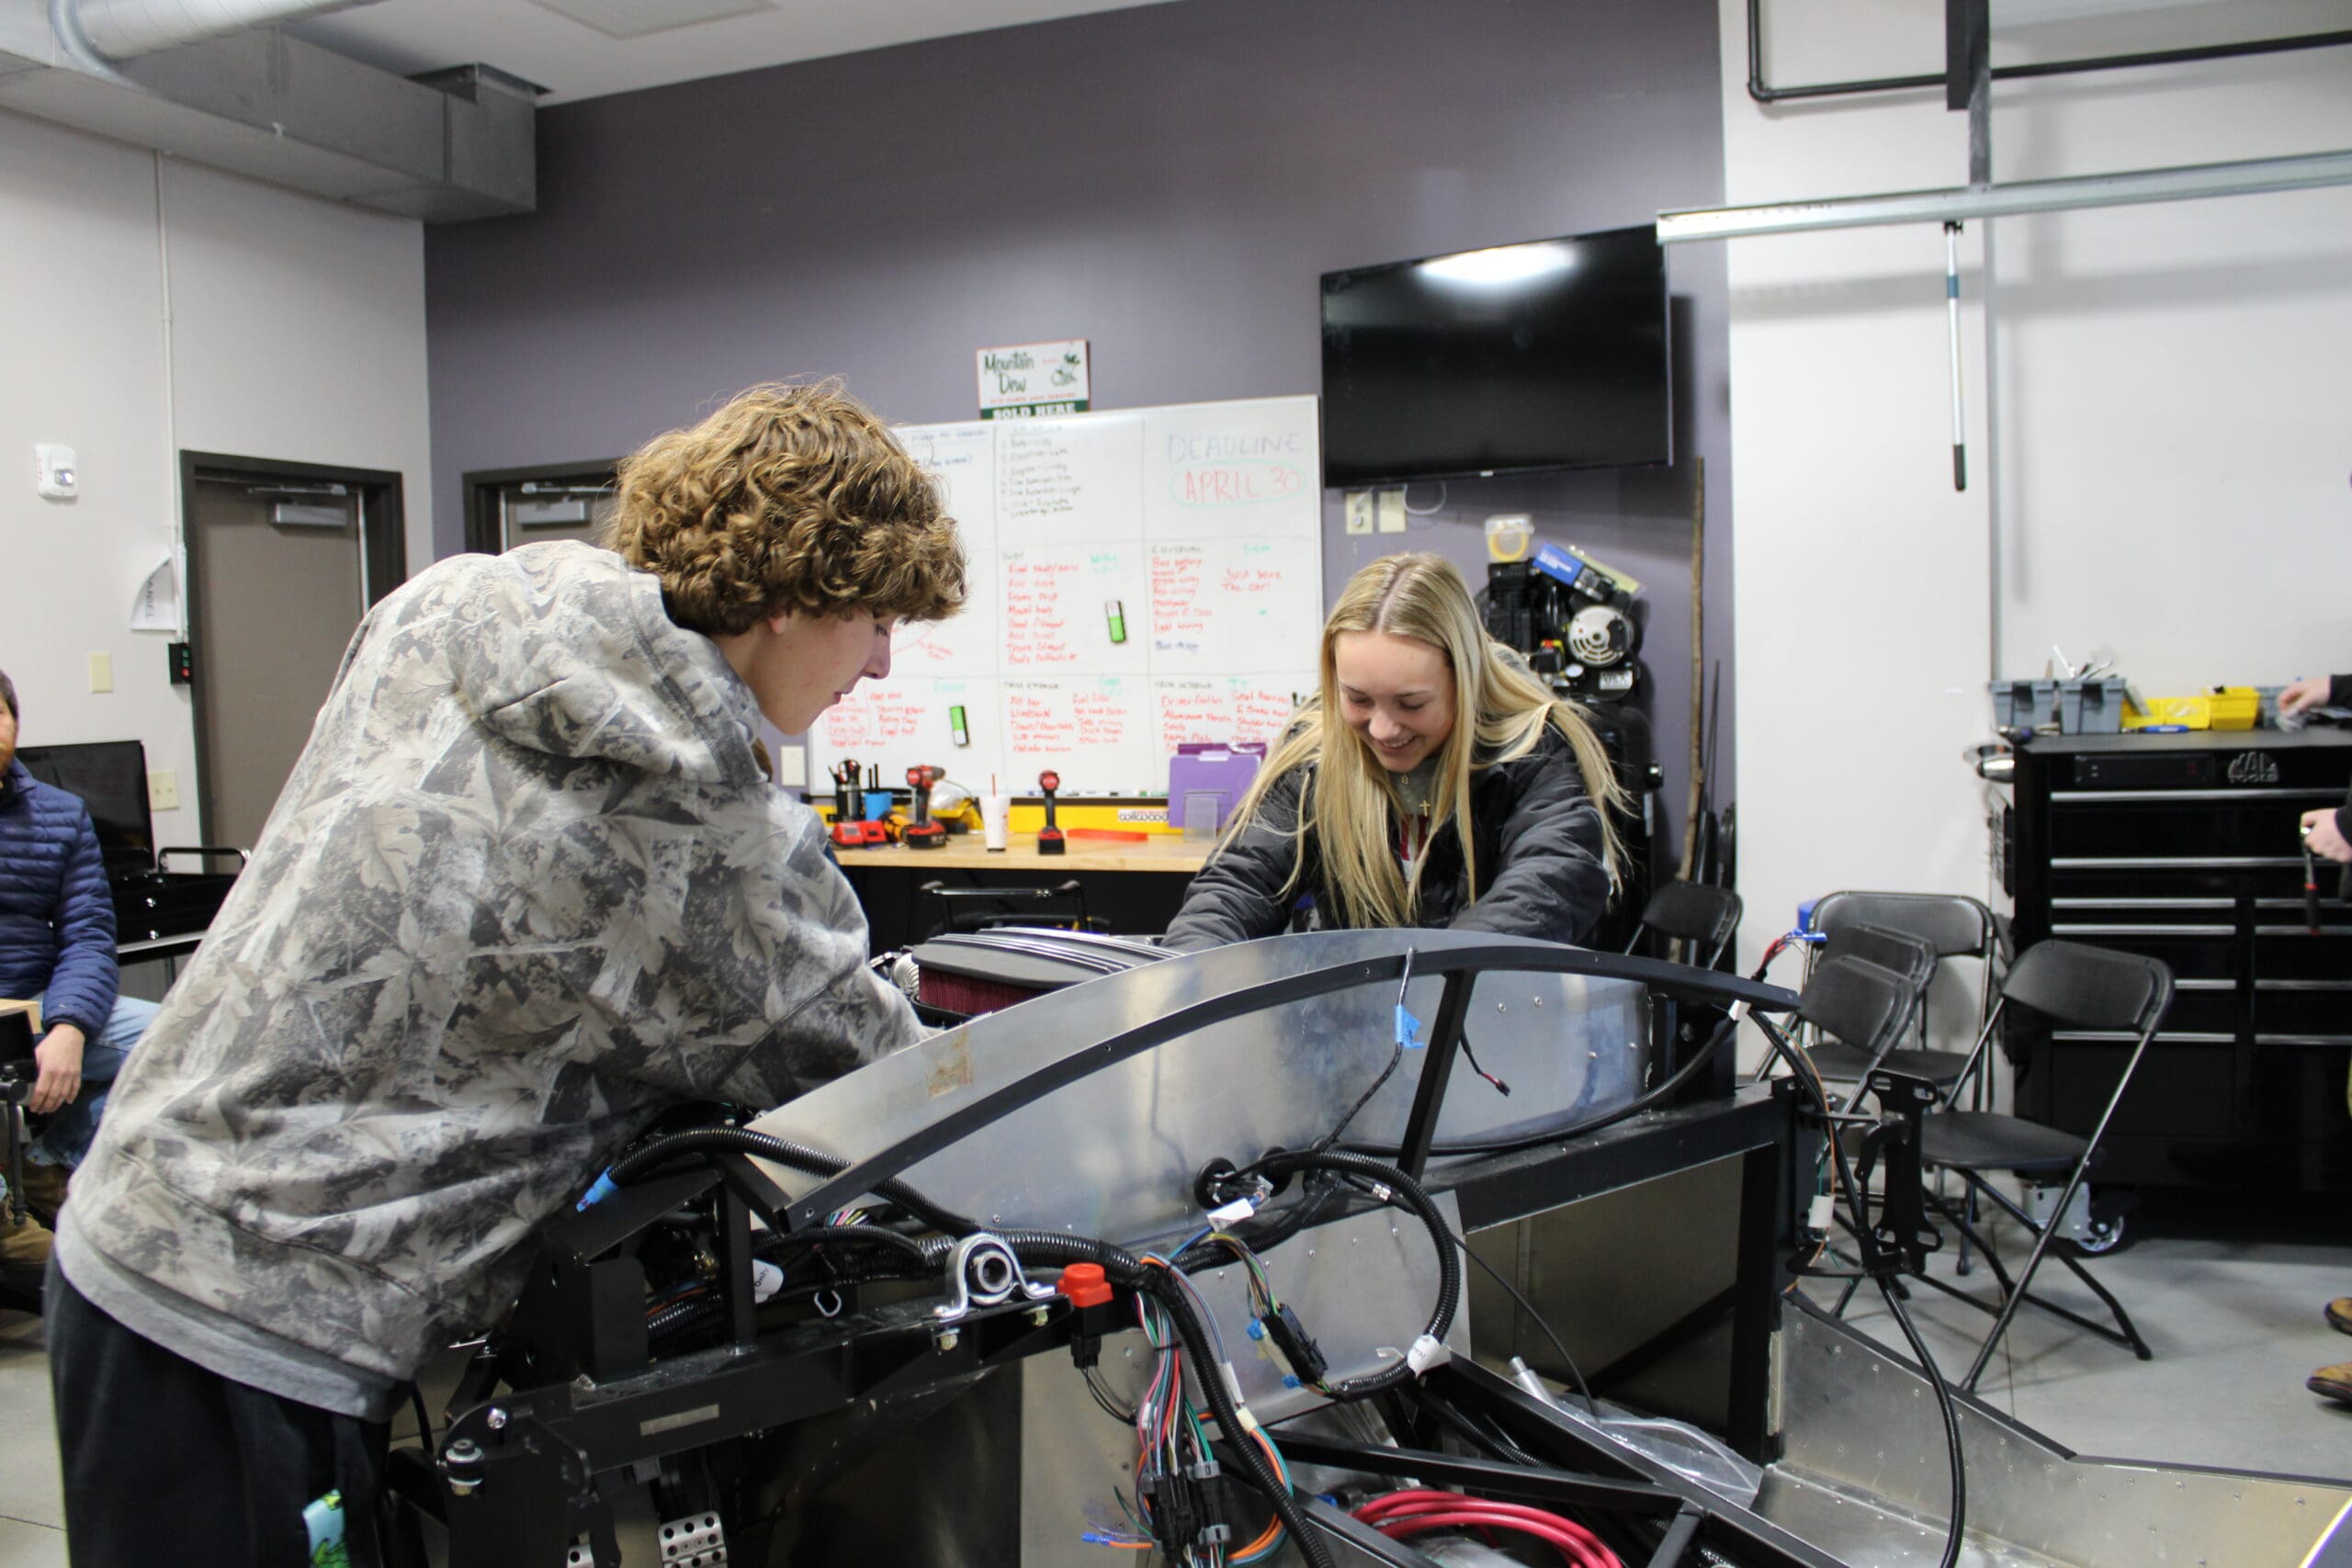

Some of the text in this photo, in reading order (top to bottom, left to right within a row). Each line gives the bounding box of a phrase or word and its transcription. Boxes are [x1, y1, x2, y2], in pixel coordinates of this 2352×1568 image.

[984, 352, 1035, 375] Mountain
[999, 374, 1026, 394] Dew
[1035, 402, 1076, 416] HERE
[1168, 433, 1303, 463] DEADLINE
[1184, 466, 1302, 502] APRIL 30
[754, 1267, 770, 1288] Only
